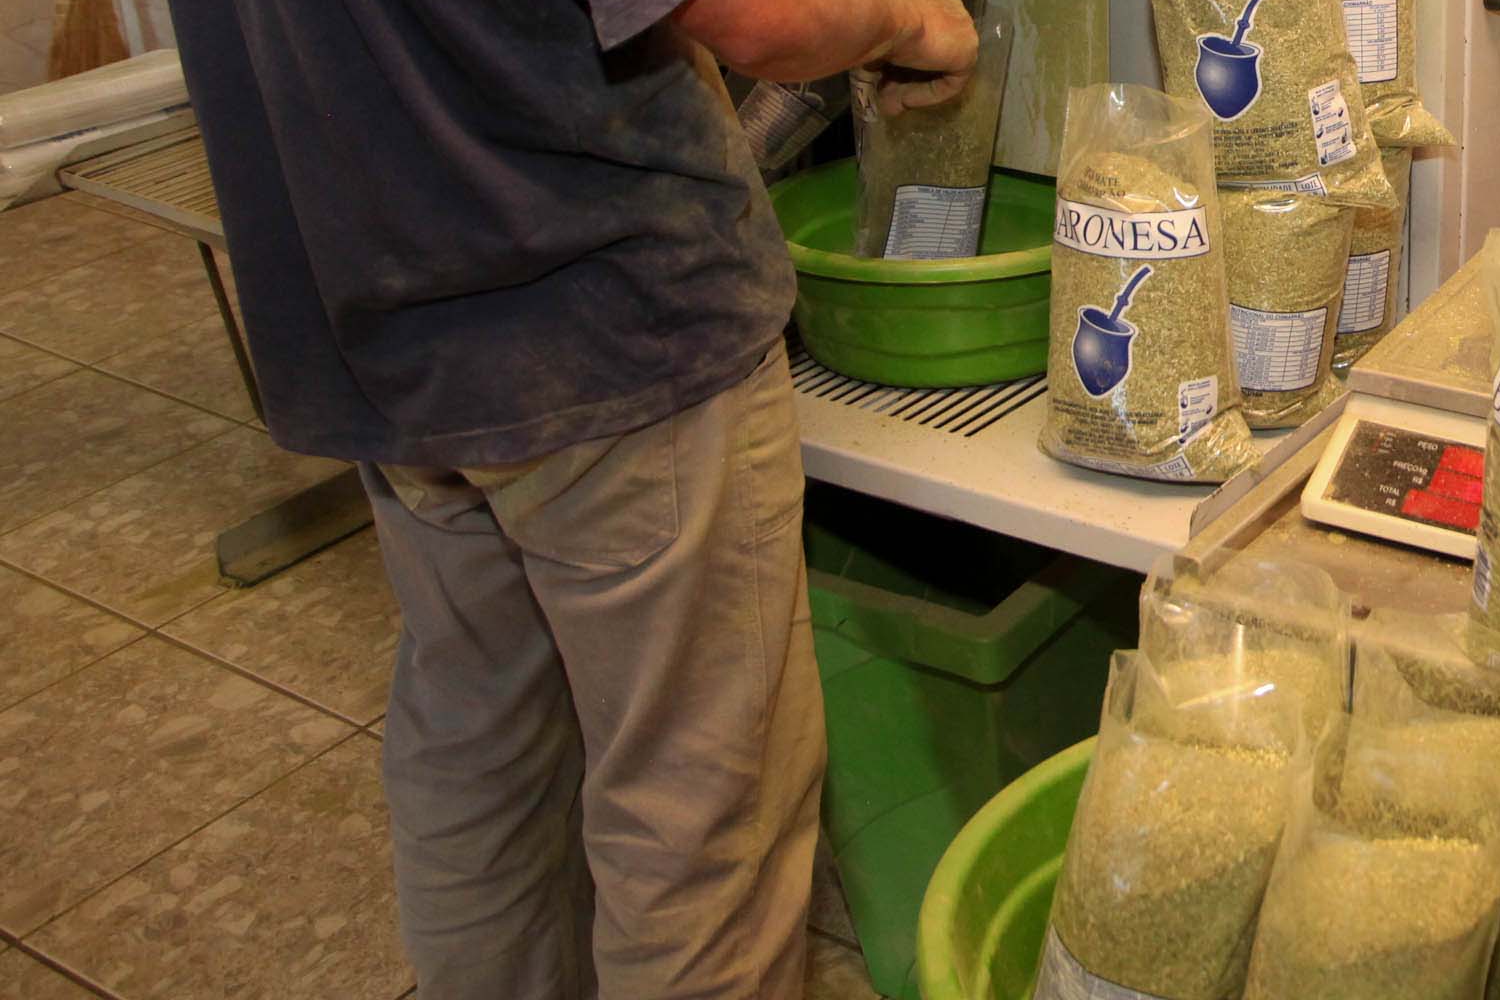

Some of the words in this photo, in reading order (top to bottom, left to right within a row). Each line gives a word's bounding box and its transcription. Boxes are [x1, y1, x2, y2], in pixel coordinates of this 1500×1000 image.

[1056, 208, 1207, 252] ARONESA
[1417, 440, 1439, 451] PESO
[1379, 484, 1400, 496] TOTAL
